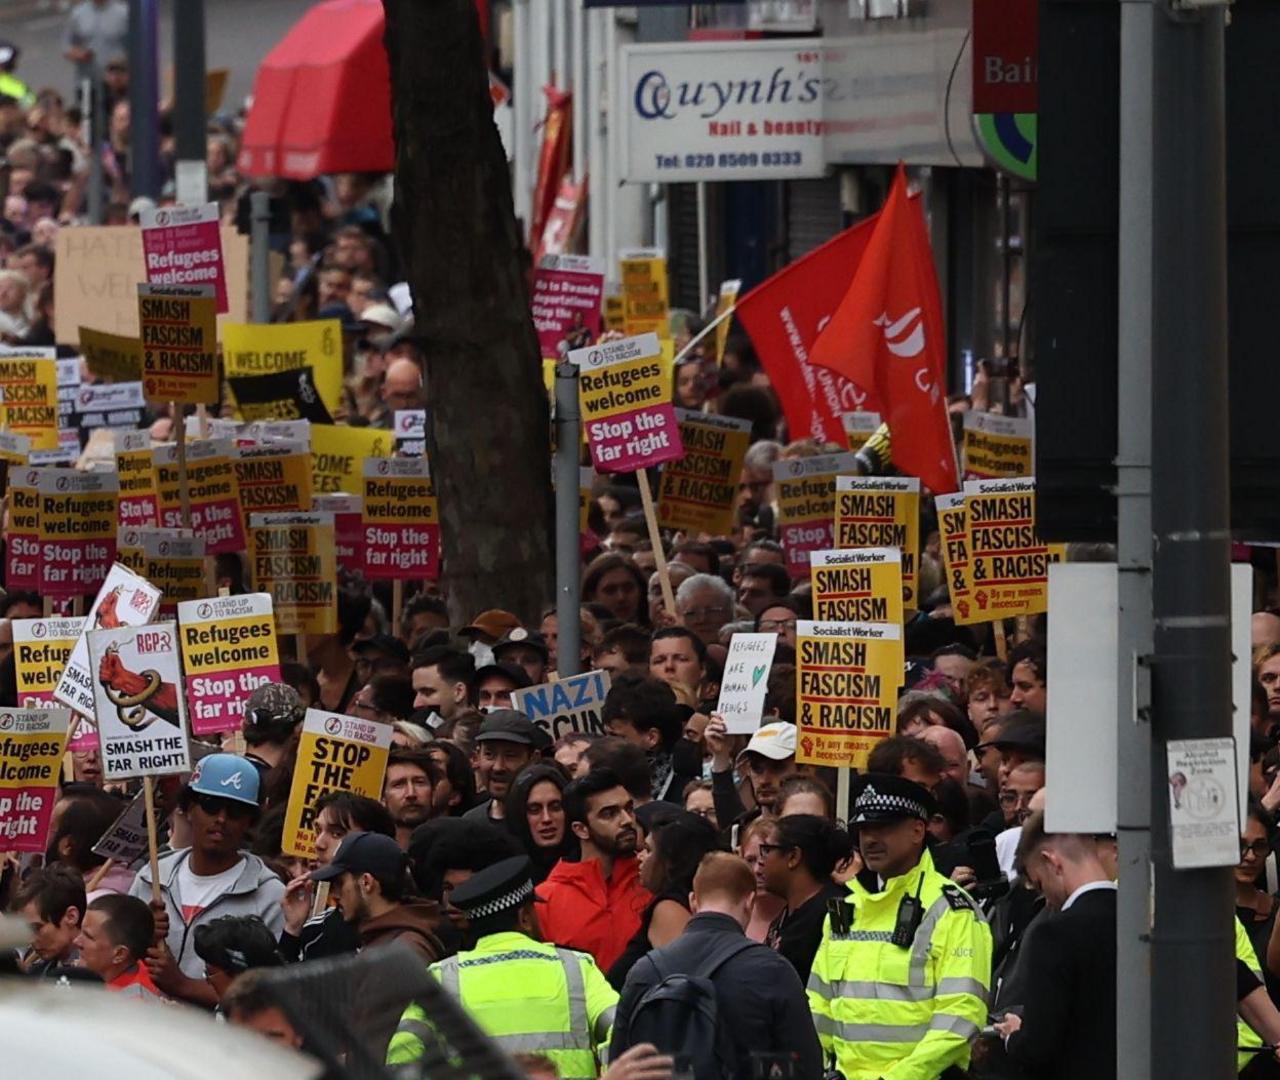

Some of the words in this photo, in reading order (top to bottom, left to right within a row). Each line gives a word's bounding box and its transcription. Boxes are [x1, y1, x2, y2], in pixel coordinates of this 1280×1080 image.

[634, 66, 821, 119] Quynh's
[709, 121, 741, 136] Nail
[764, 119, 825, 136] beauty
[685, 153, 715, 167] 020
[762, 151, 802, 165] 0333
[148, 250, 219, 270] Refugees
[142, 300, 189, 320] SMASH
[143, 326, 203, 345] FASCISM
[580, 363, 660, 393] Refugees
[585, 384, 661, 412] welcome
[591, 421, 633, 442] Stop
[635, 412, 665, 430] the
[596, 445, 622, 463] far
[626, 431, 669, 456] right
[366, 481, 433, 500] Refugees
[44, 497, 115, 516] Refugees
[367, 503, 431, 517] welcome
[841, 495, 895, 516] SMASH
[970, 497, 1031, 521] SMASH
[45, 518, 110, 534] welcome
[840, 524, 906, 545] FASCISM
[366, 527, 397, 546] Stop
[402, 527, 429, 545] the
[43, 545, 81, 563] Stop
[85, 545, 107, 559] the
[366, 548, 387, 565] far
[390, 548, 428, 568] right
[44, 566, 67, 582] far
[72, 565, 107, 584] right
[816, 568, 871, 593] SMASH
[818, 598, 887, 621] FASCISM
[186, 623, 271, 644] Refugees
[813, 626, 852, 636] Socialist
[852, 628, 884, 637] Worker
[137, 634, 160, 652] RCP
[731, 640, 767, 651] REFUGEES
[189, 645, 269, 666] welcome
[801, 641, 866, 666] SMASH
[727, 663, 744, 675] ARE
[723, 682, 747, 693] HUMAN
[801, 672, 880, 698] FASCISM
[524, 675, 605, 720] NAZI
[194, 700, 224, 719] far
[720, 703, 748, 713] BEINGS
[801, 703, 813, 726] &
[820, 705, 891, 730] RACISM
[105, 739, 154, 755] SMASH
[154, 737, 183, 750] THE
[314, 738, 370, 767] STOP
[108, 758, 132, 772] FAR
[139, 753, 185, 769] RIGHT!
[816, 751, 855, 763] necessary
[311, 761, 354, 789] THE
[15, 792, 43, 811] the
